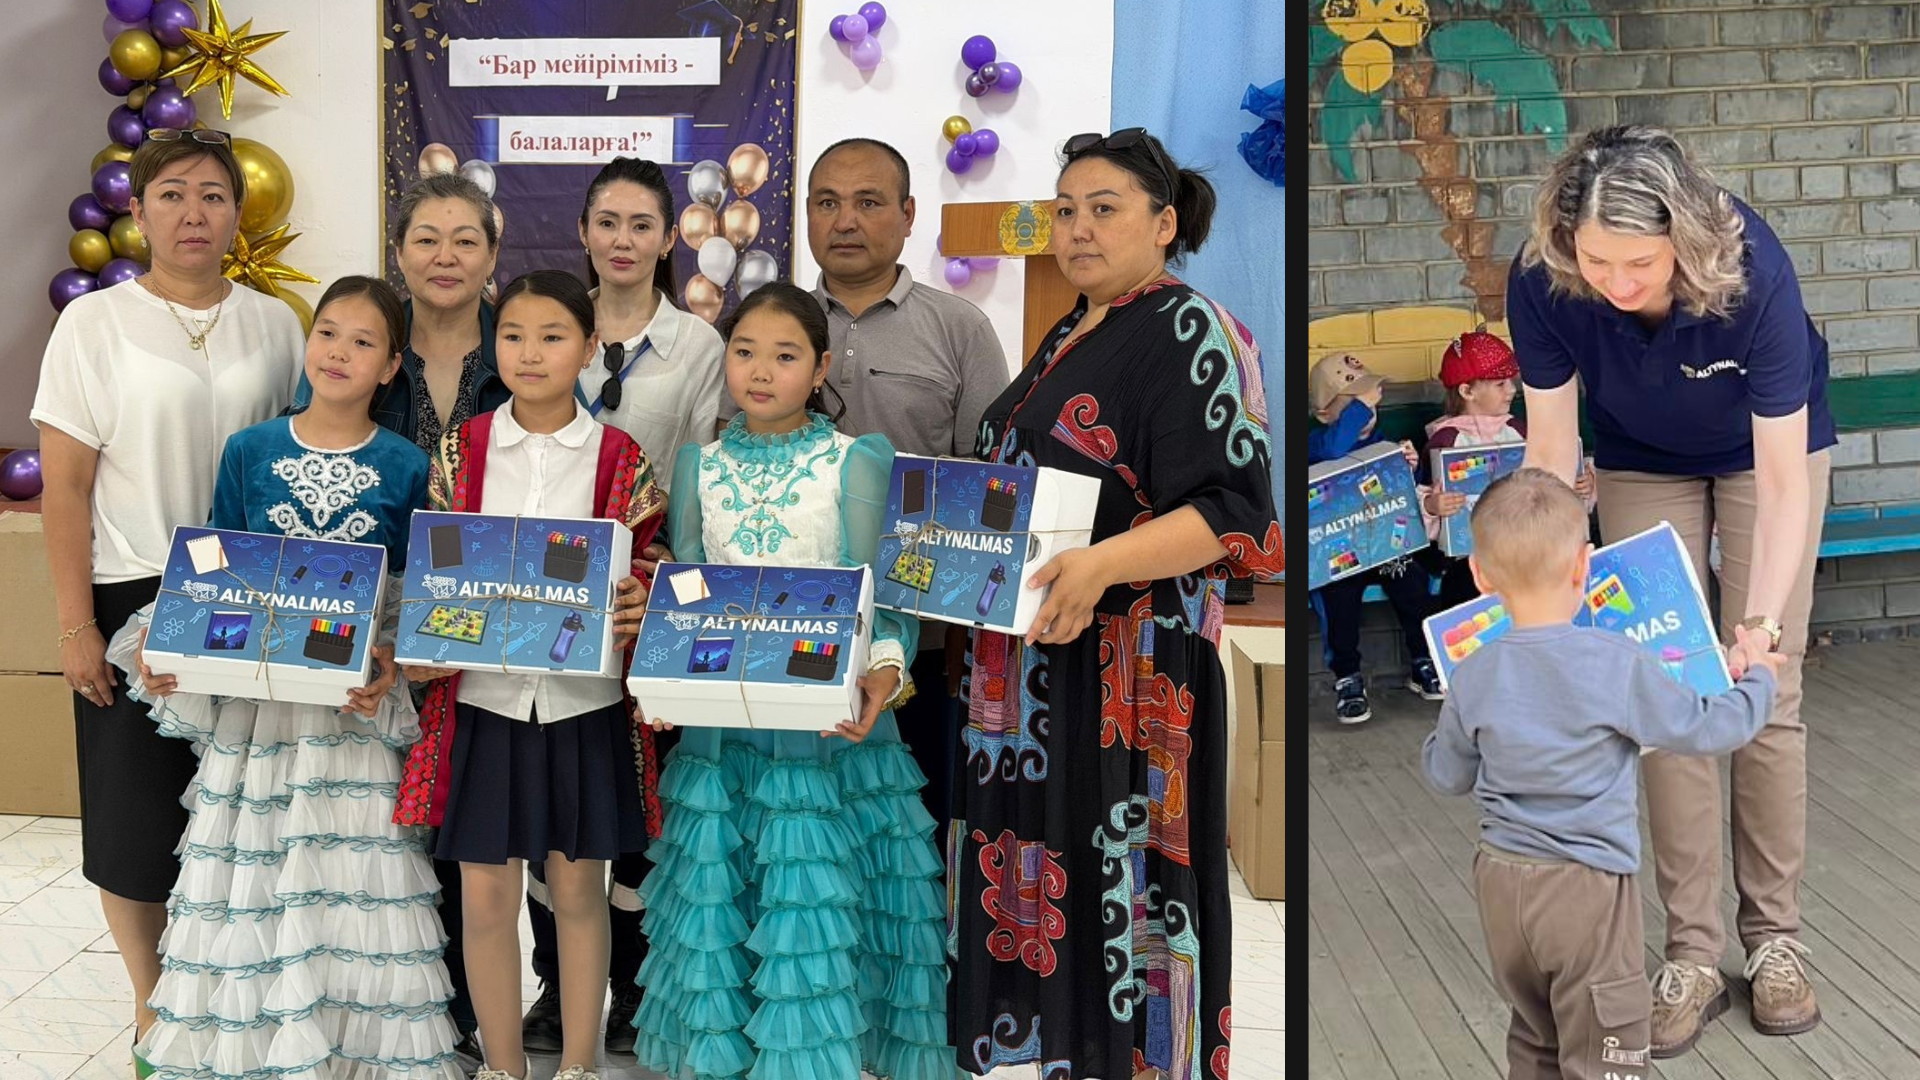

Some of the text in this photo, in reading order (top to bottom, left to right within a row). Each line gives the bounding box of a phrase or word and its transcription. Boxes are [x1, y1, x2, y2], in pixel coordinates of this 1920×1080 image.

[479, 54, 537, 79] “Бар
[544, 53, 678, 79] мейіріміміз
[510, 130, 653, 156] балаларға!”
[1325, 496, 1408, 536] ALTYNALMAS
[918, 527, 1014, 555] ALTYNALMAS
[219, 588, 356, 614] ALTYNALMAS
[458, 580, 590, 604] ALTYNALMAS
[701, 615, 839, 635] ALTYNALMAS
